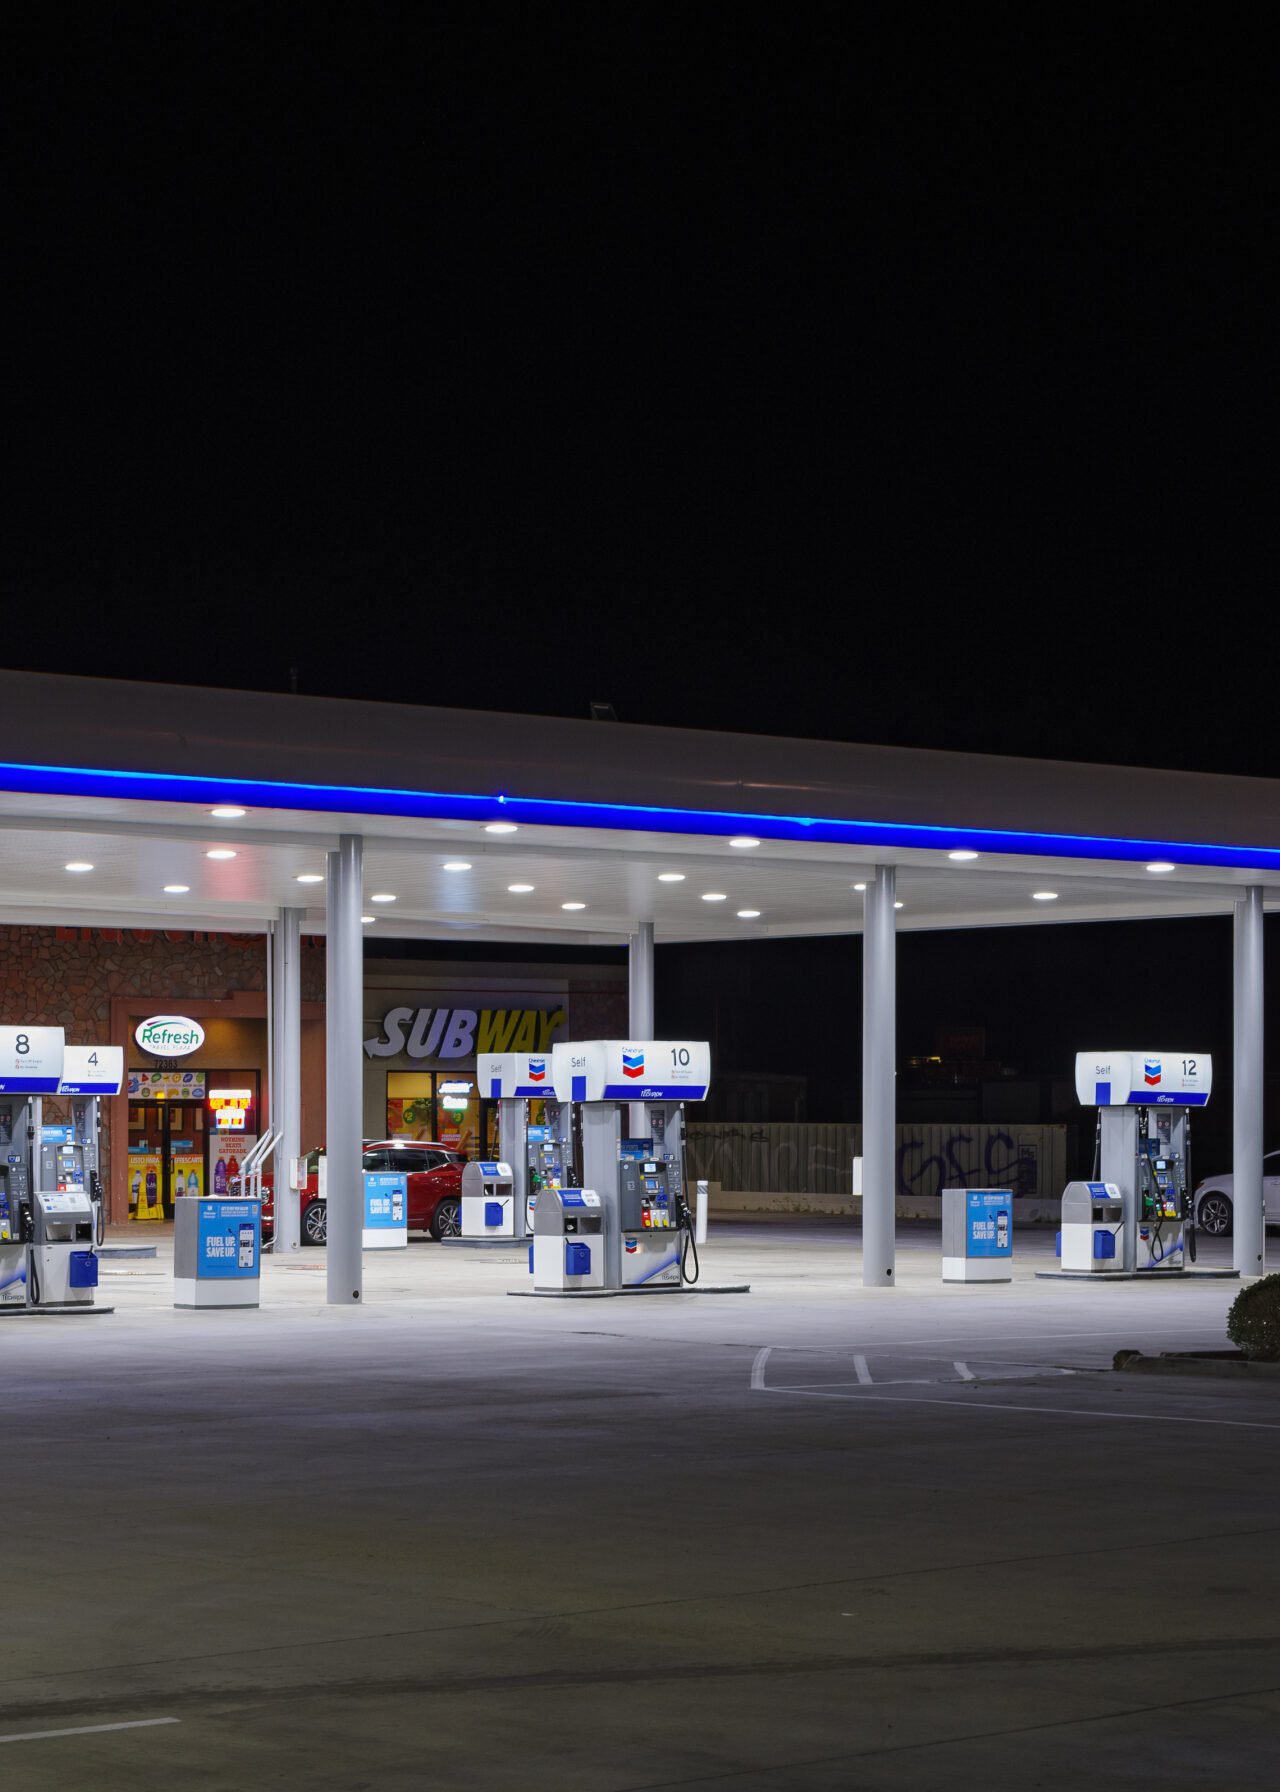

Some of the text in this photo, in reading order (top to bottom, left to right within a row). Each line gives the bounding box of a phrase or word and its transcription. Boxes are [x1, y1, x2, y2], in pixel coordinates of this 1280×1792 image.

[141, 1027, 200, 1045] Refresh
[363, 1006, 568, 1060] SUBWAY
[15, 1034, 30, 1055] 8
[87, 1052, 99, 1067] 4
[571, 1057, 586, 1068] Self
[671, 1048, 691, 1066] 10
[1095, 1065, 1111, 1075] Self
[1182, 1060, 1198, 1077] 12
[206, 1236, 224, 1247] FUEL
[206, 1247, 224, 1257] SAVE
